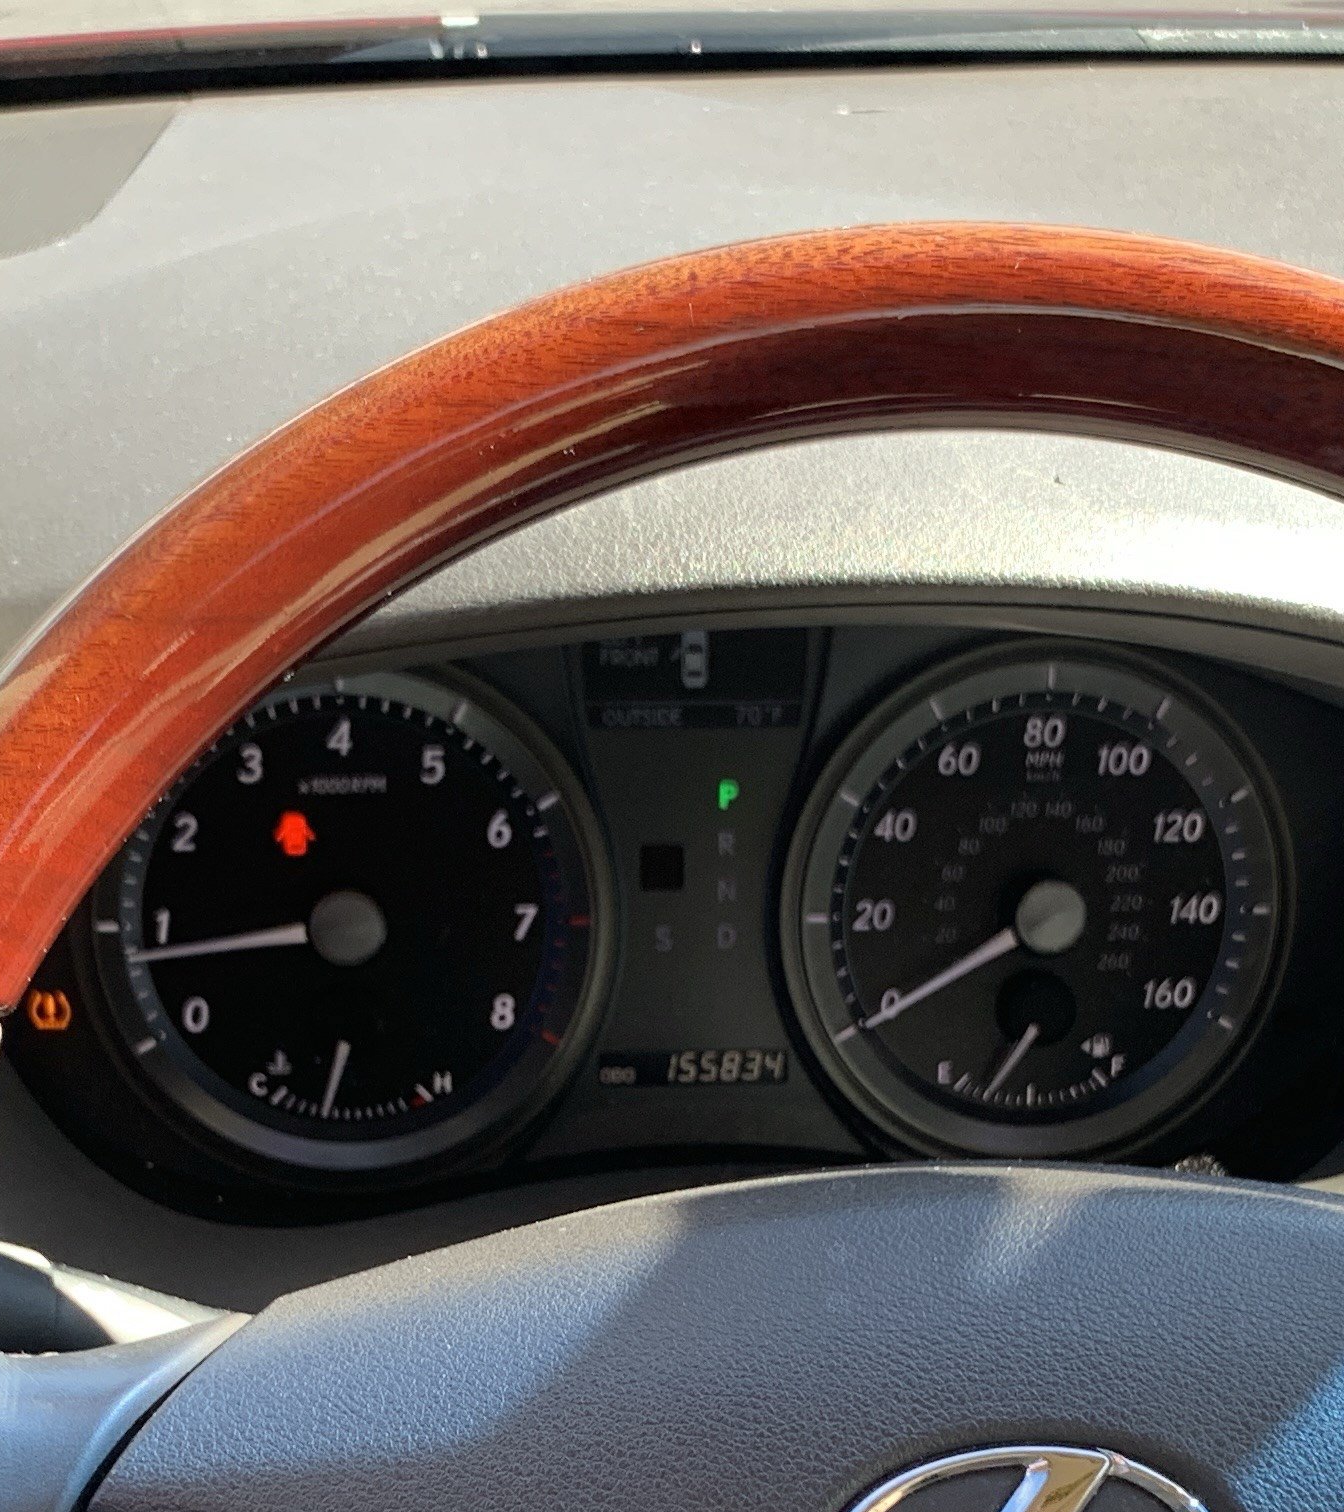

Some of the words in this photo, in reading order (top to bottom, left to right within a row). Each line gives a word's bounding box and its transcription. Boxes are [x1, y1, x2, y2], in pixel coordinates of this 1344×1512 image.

[326, 717, 353, 757] 4
[1023, 715, 1066, 748] 80
[237, 744, 264, 784] 3
[420, 743, 446, 785] 5
[938, 743, 981, 777] 60
[1097, 743, 1152, 777] 100
[718, 778, 740, 811] P
[171, 812, 198, 853] 2
[486, 808, 514, 849] 6
[873, 810, 918, 842] 40
[1152, 810, 1205, 844] 120
[155, 907, 170, 941] 1
[513, 902, 538, 941] 7
[852, 900, 895, 932] 20
[1170, 892, 1222, 925] 140
[716, 922, 737, 950] D
[1143, 977, 1197, 1010] 160
[182, 997, 209, 1033] 0
[489, 992, 515, 1030] 8
[433, 1069, 453, 1095] H
[667, 1049, 786, 1083] 155834
[247, 1071, 269, 1097] C
